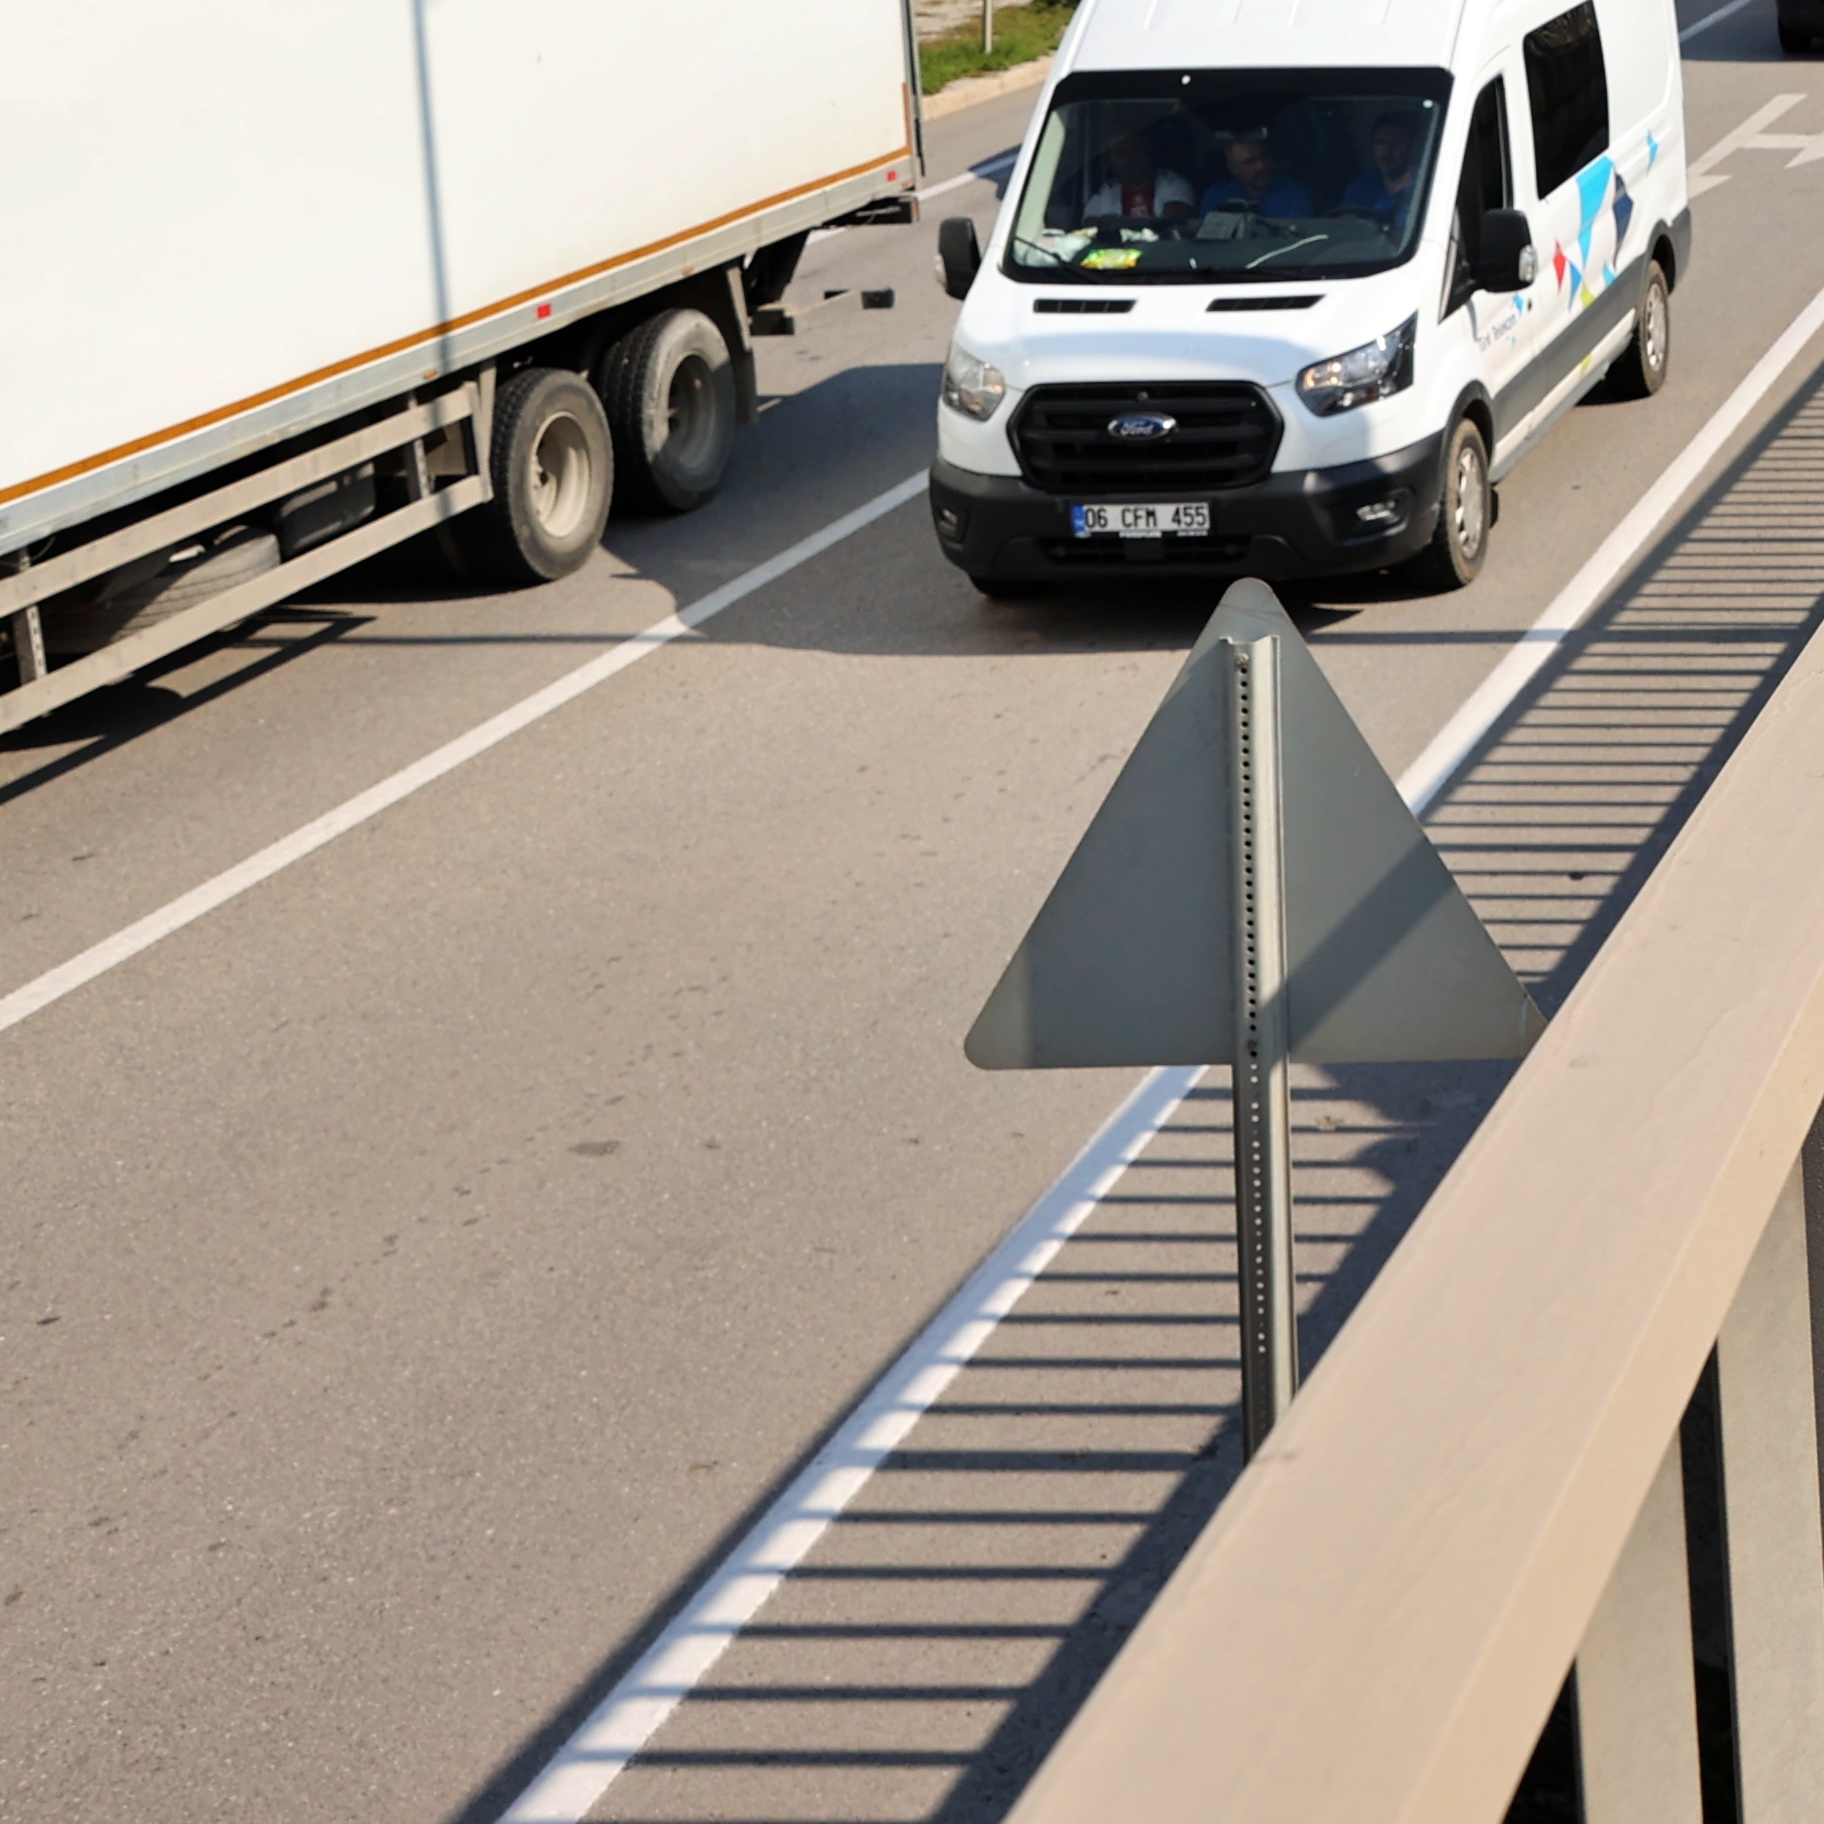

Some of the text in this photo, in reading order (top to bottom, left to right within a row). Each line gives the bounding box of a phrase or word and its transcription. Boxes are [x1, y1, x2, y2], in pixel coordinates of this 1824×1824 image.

[1085, 505, 1207, 529] 06 CFM 455
